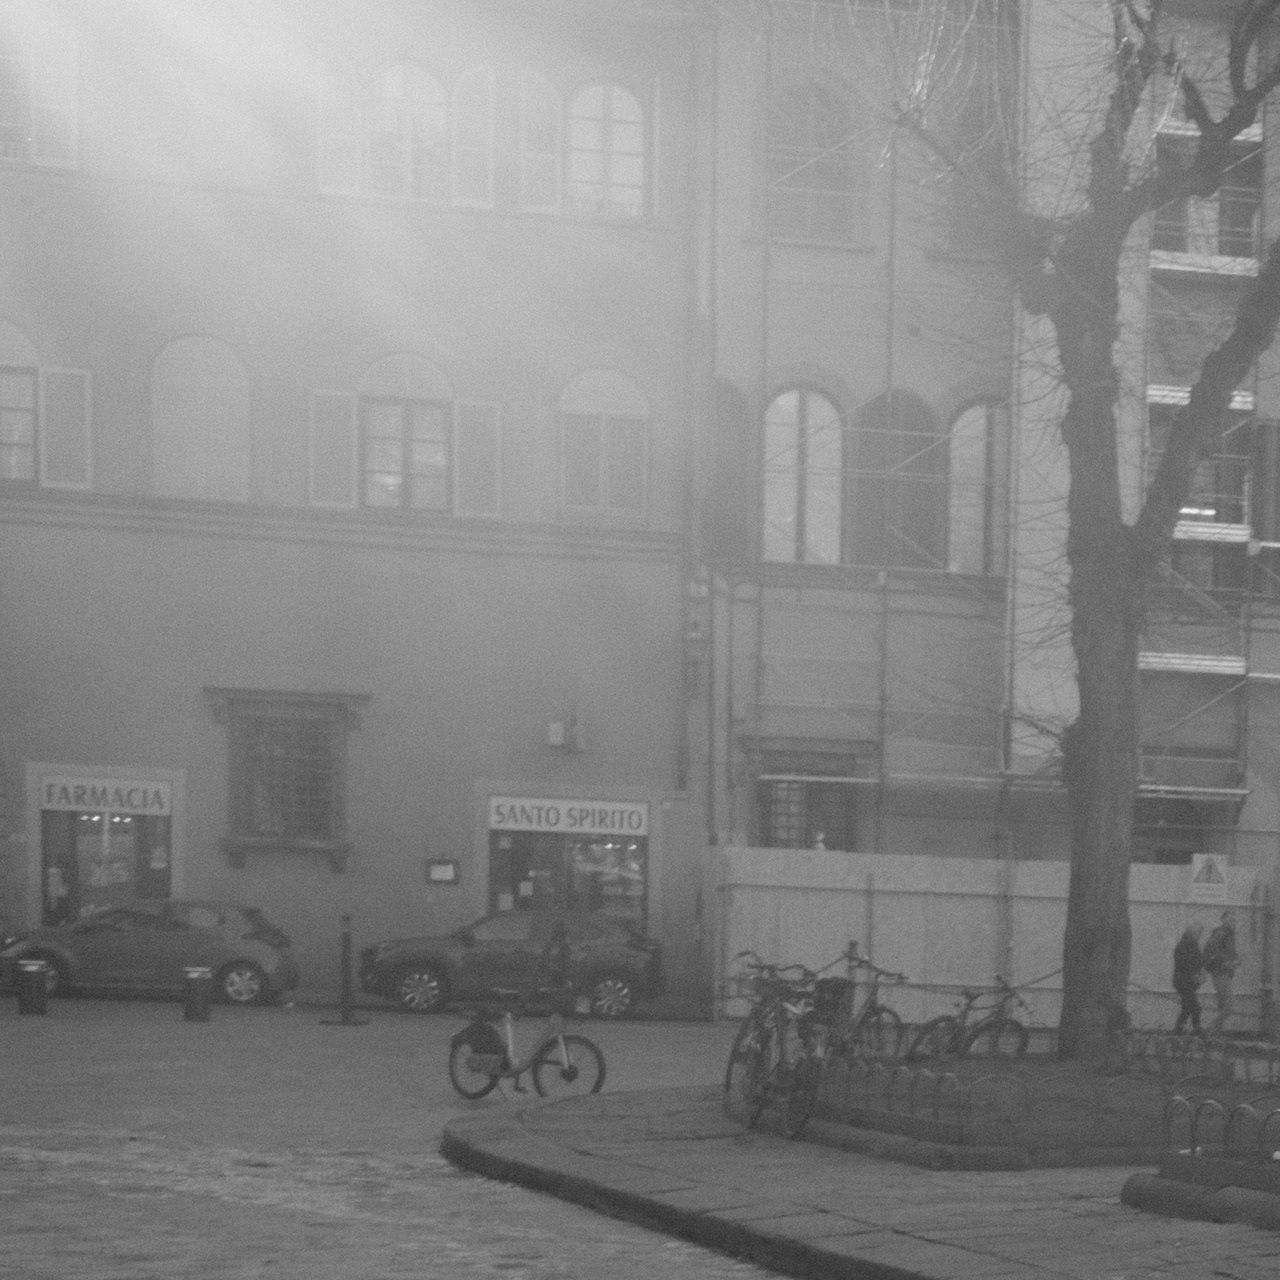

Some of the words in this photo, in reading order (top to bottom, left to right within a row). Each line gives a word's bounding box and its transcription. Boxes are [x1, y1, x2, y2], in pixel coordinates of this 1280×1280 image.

[45, 783, 165, 810] FARMACIA
[495, 803, 561, 828] SANTO
[566, 806, 643, 831] SPIRITO
